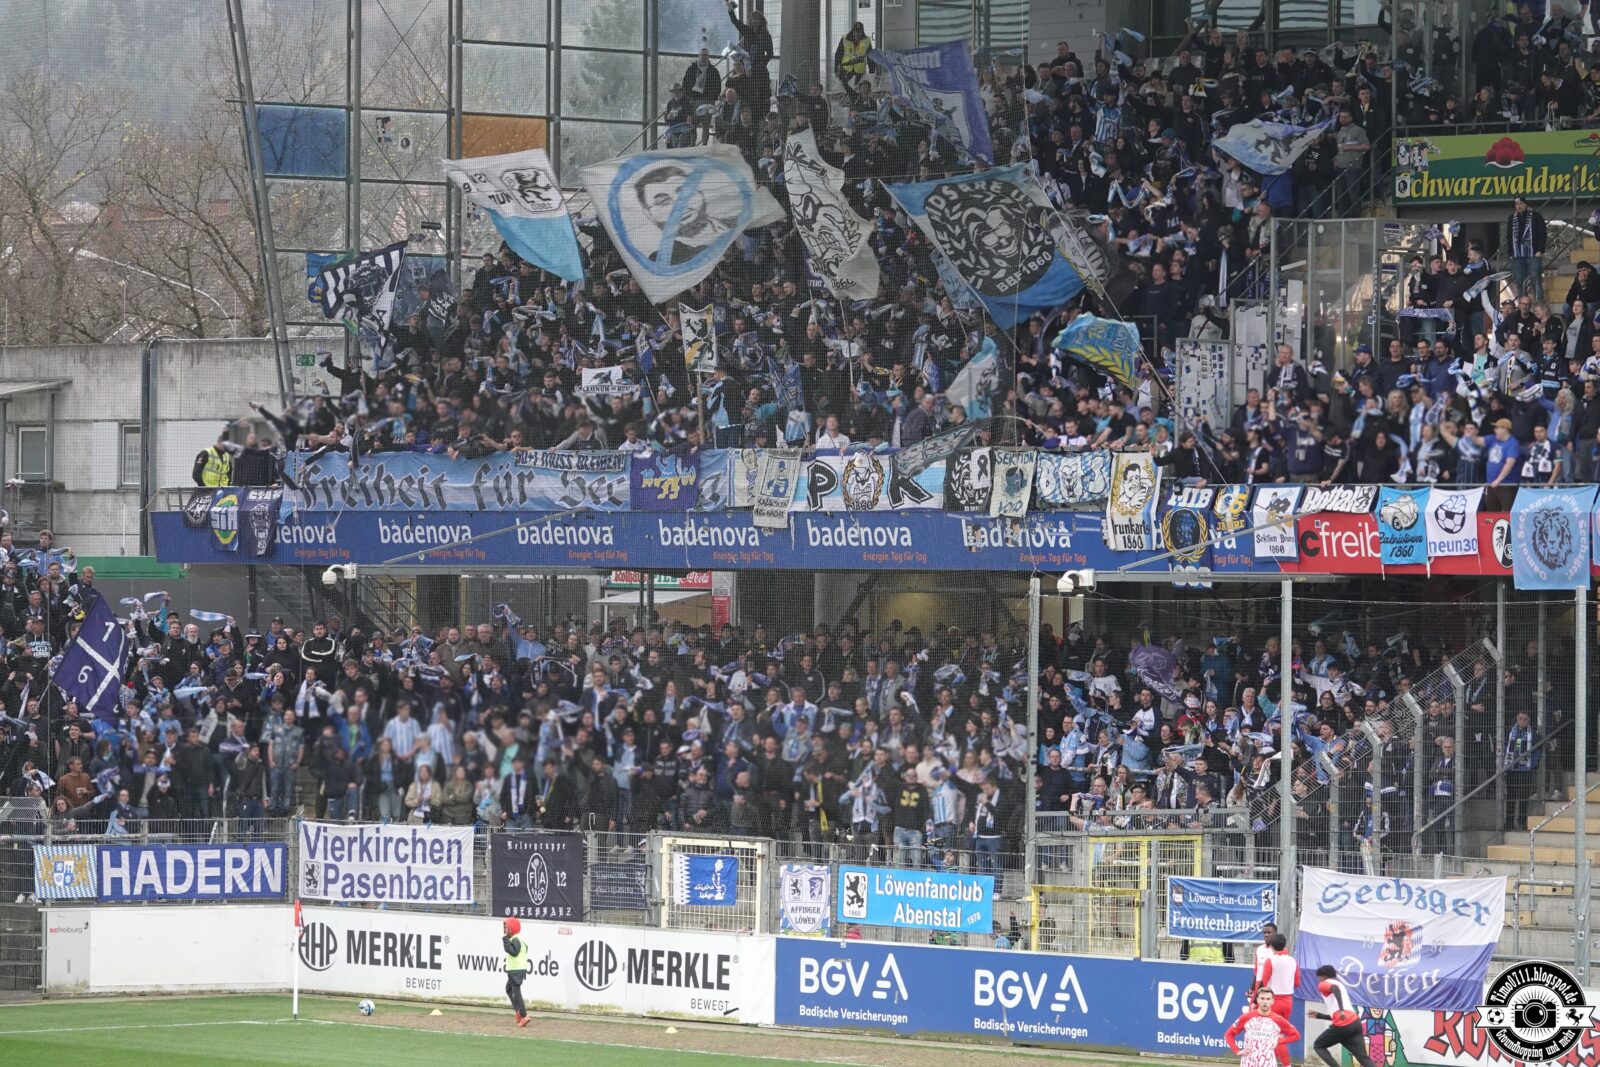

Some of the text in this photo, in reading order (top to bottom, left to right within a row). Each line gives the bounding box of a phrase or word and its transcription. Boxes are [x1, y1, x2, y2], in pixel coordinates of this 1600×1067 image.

[378, 518, 473, 544] badenova
[516, 518, 614, 544] badenova
[658, 519, 760, 546] badenova
[806, 519, 912, 546] badenova
[1390, 545, 1414, 557] 1860
[1429, 537, 1478, 554] neun30
[1048, 553, 1061, 565] Tag
[1061, 553, 1073, 563] für
[1074, 553, 1087, 565] Tag
[1213, 554, 1226, 566] Tag
[1227, 554, 1239, 564] für
[303, 824, 463, 865] Vierkirchen
[102, 848, 283, 896] HADERN
[323, 863, 471, 901] Pasenbach
[508, 872, 520, 887] 20
[556, 871, 567, 887] 12
[876, 874, 983, 903] Löwenfanclub
[1188, 891, 1258, 906] Löwen-Fan-Club
[790, 906, 821, 914] AFFINGER
[1316, 879, 1490, 926] Sechzger
[893, 902, 961, 928] Abenstal
[405, 977, 442, 990] BEWEGT
[800, 956, 870, 997] BGV
[974, 969, 1048, 1010] BGV
[691, 998, 730, 1012] BEWEGT
[1158, 981, 1235, 1024] BGV
[799, 1005, 908, 1026] Badische Versicherungen
[974, 1018, 1088, 1038] Badische Versicherungen
[1158, 1032, 1200, 1045] Badische
